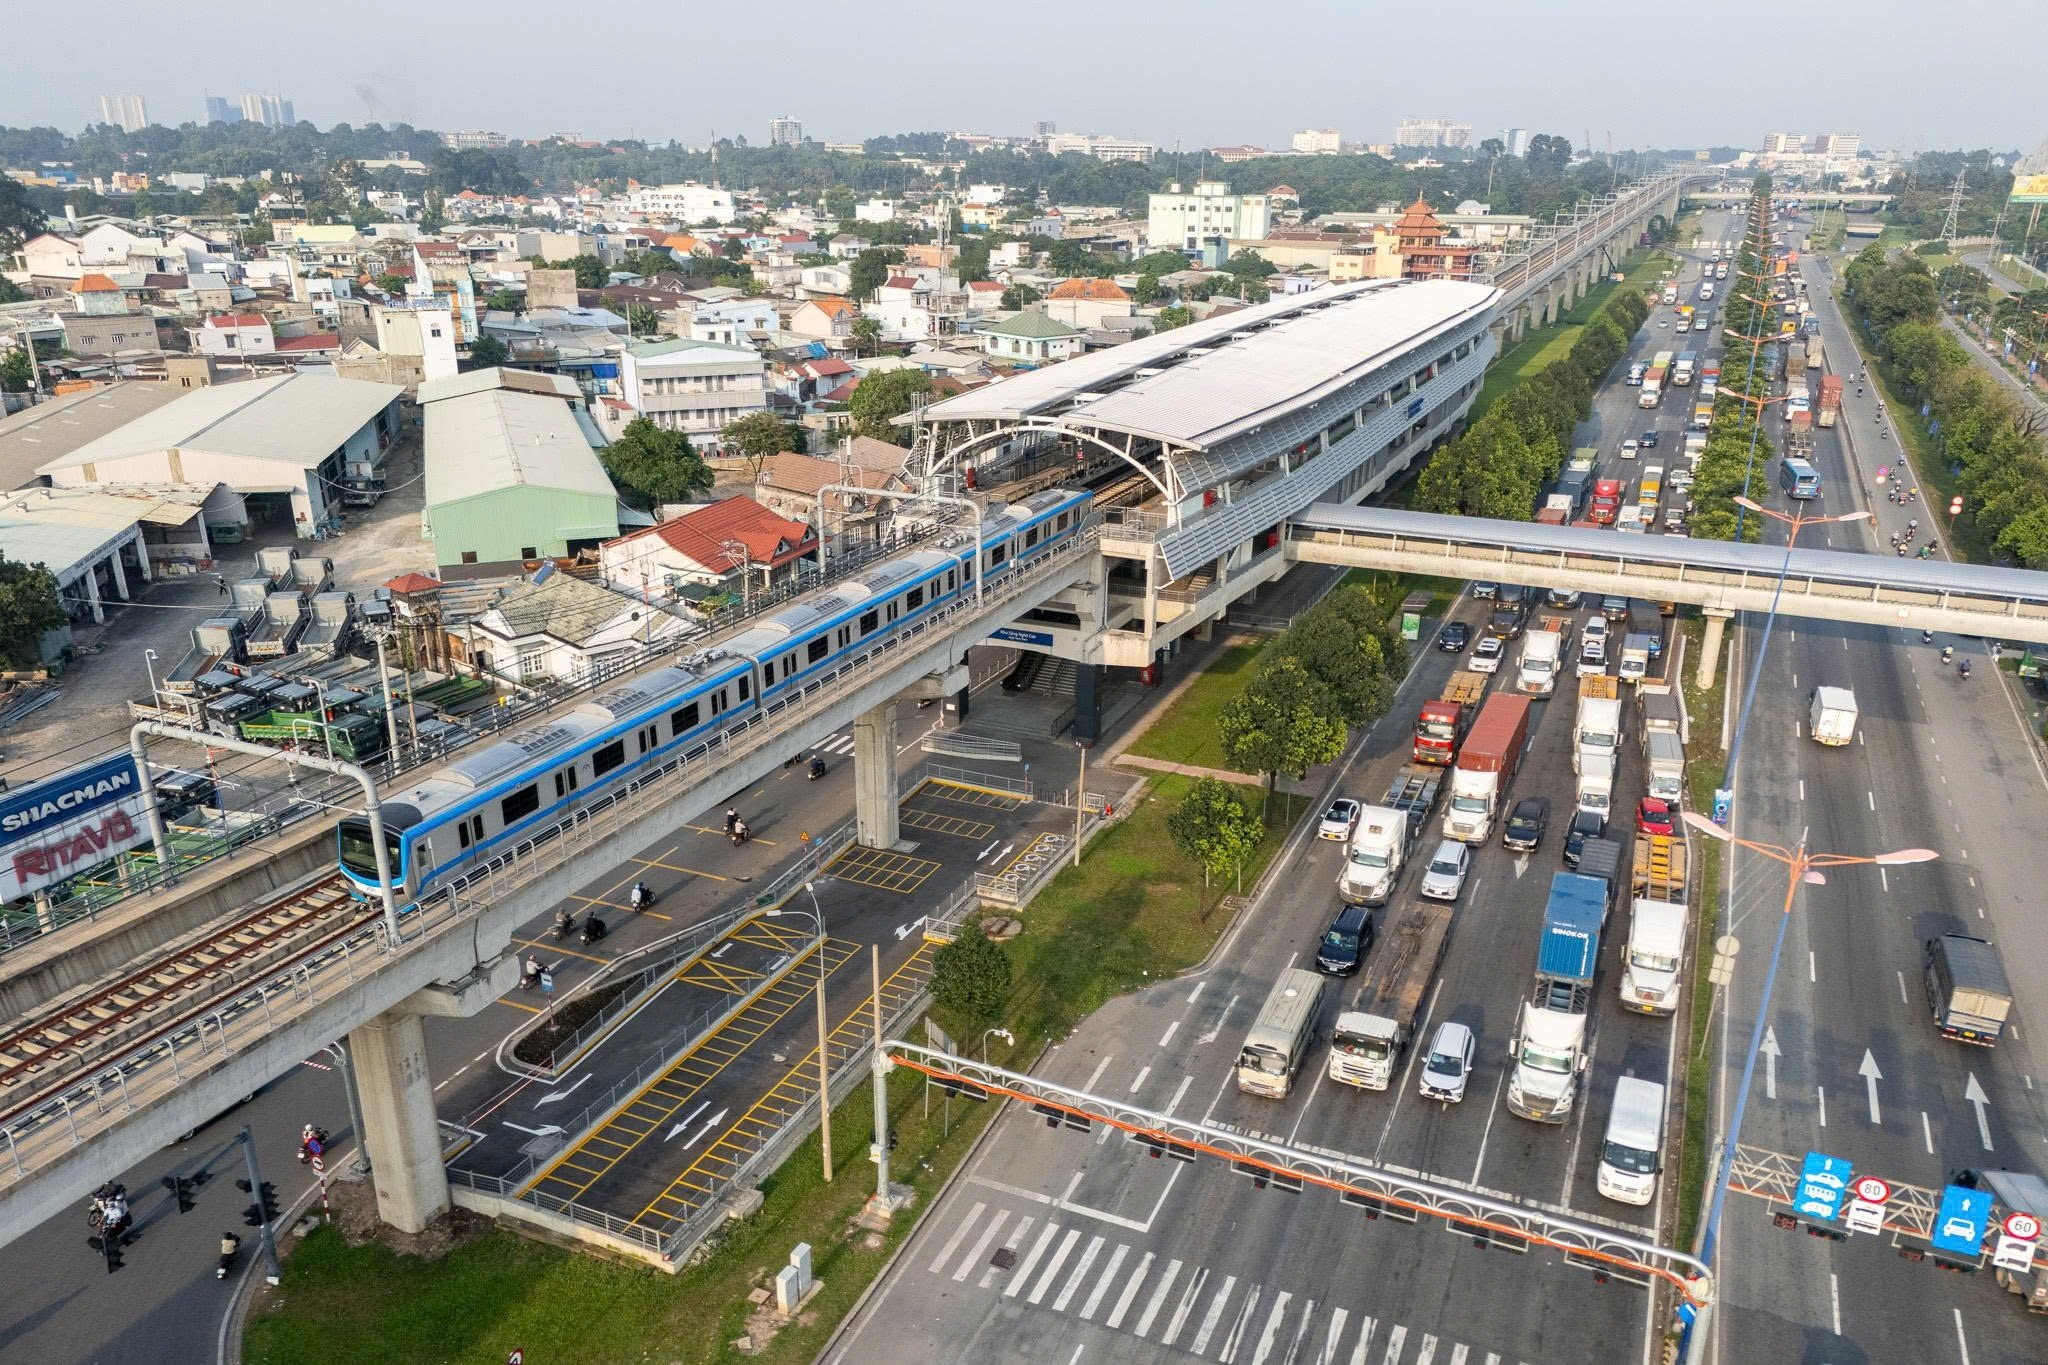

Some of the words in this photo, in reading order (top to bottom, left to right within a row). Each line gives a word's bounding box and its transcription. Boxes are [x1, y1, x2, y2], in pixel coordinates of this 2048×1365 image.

[2, 771, 130, 832] SHACMAN
[1863, 1183, 1881, 1197] 80
[2014, 1220, 2032, 1233] 60
